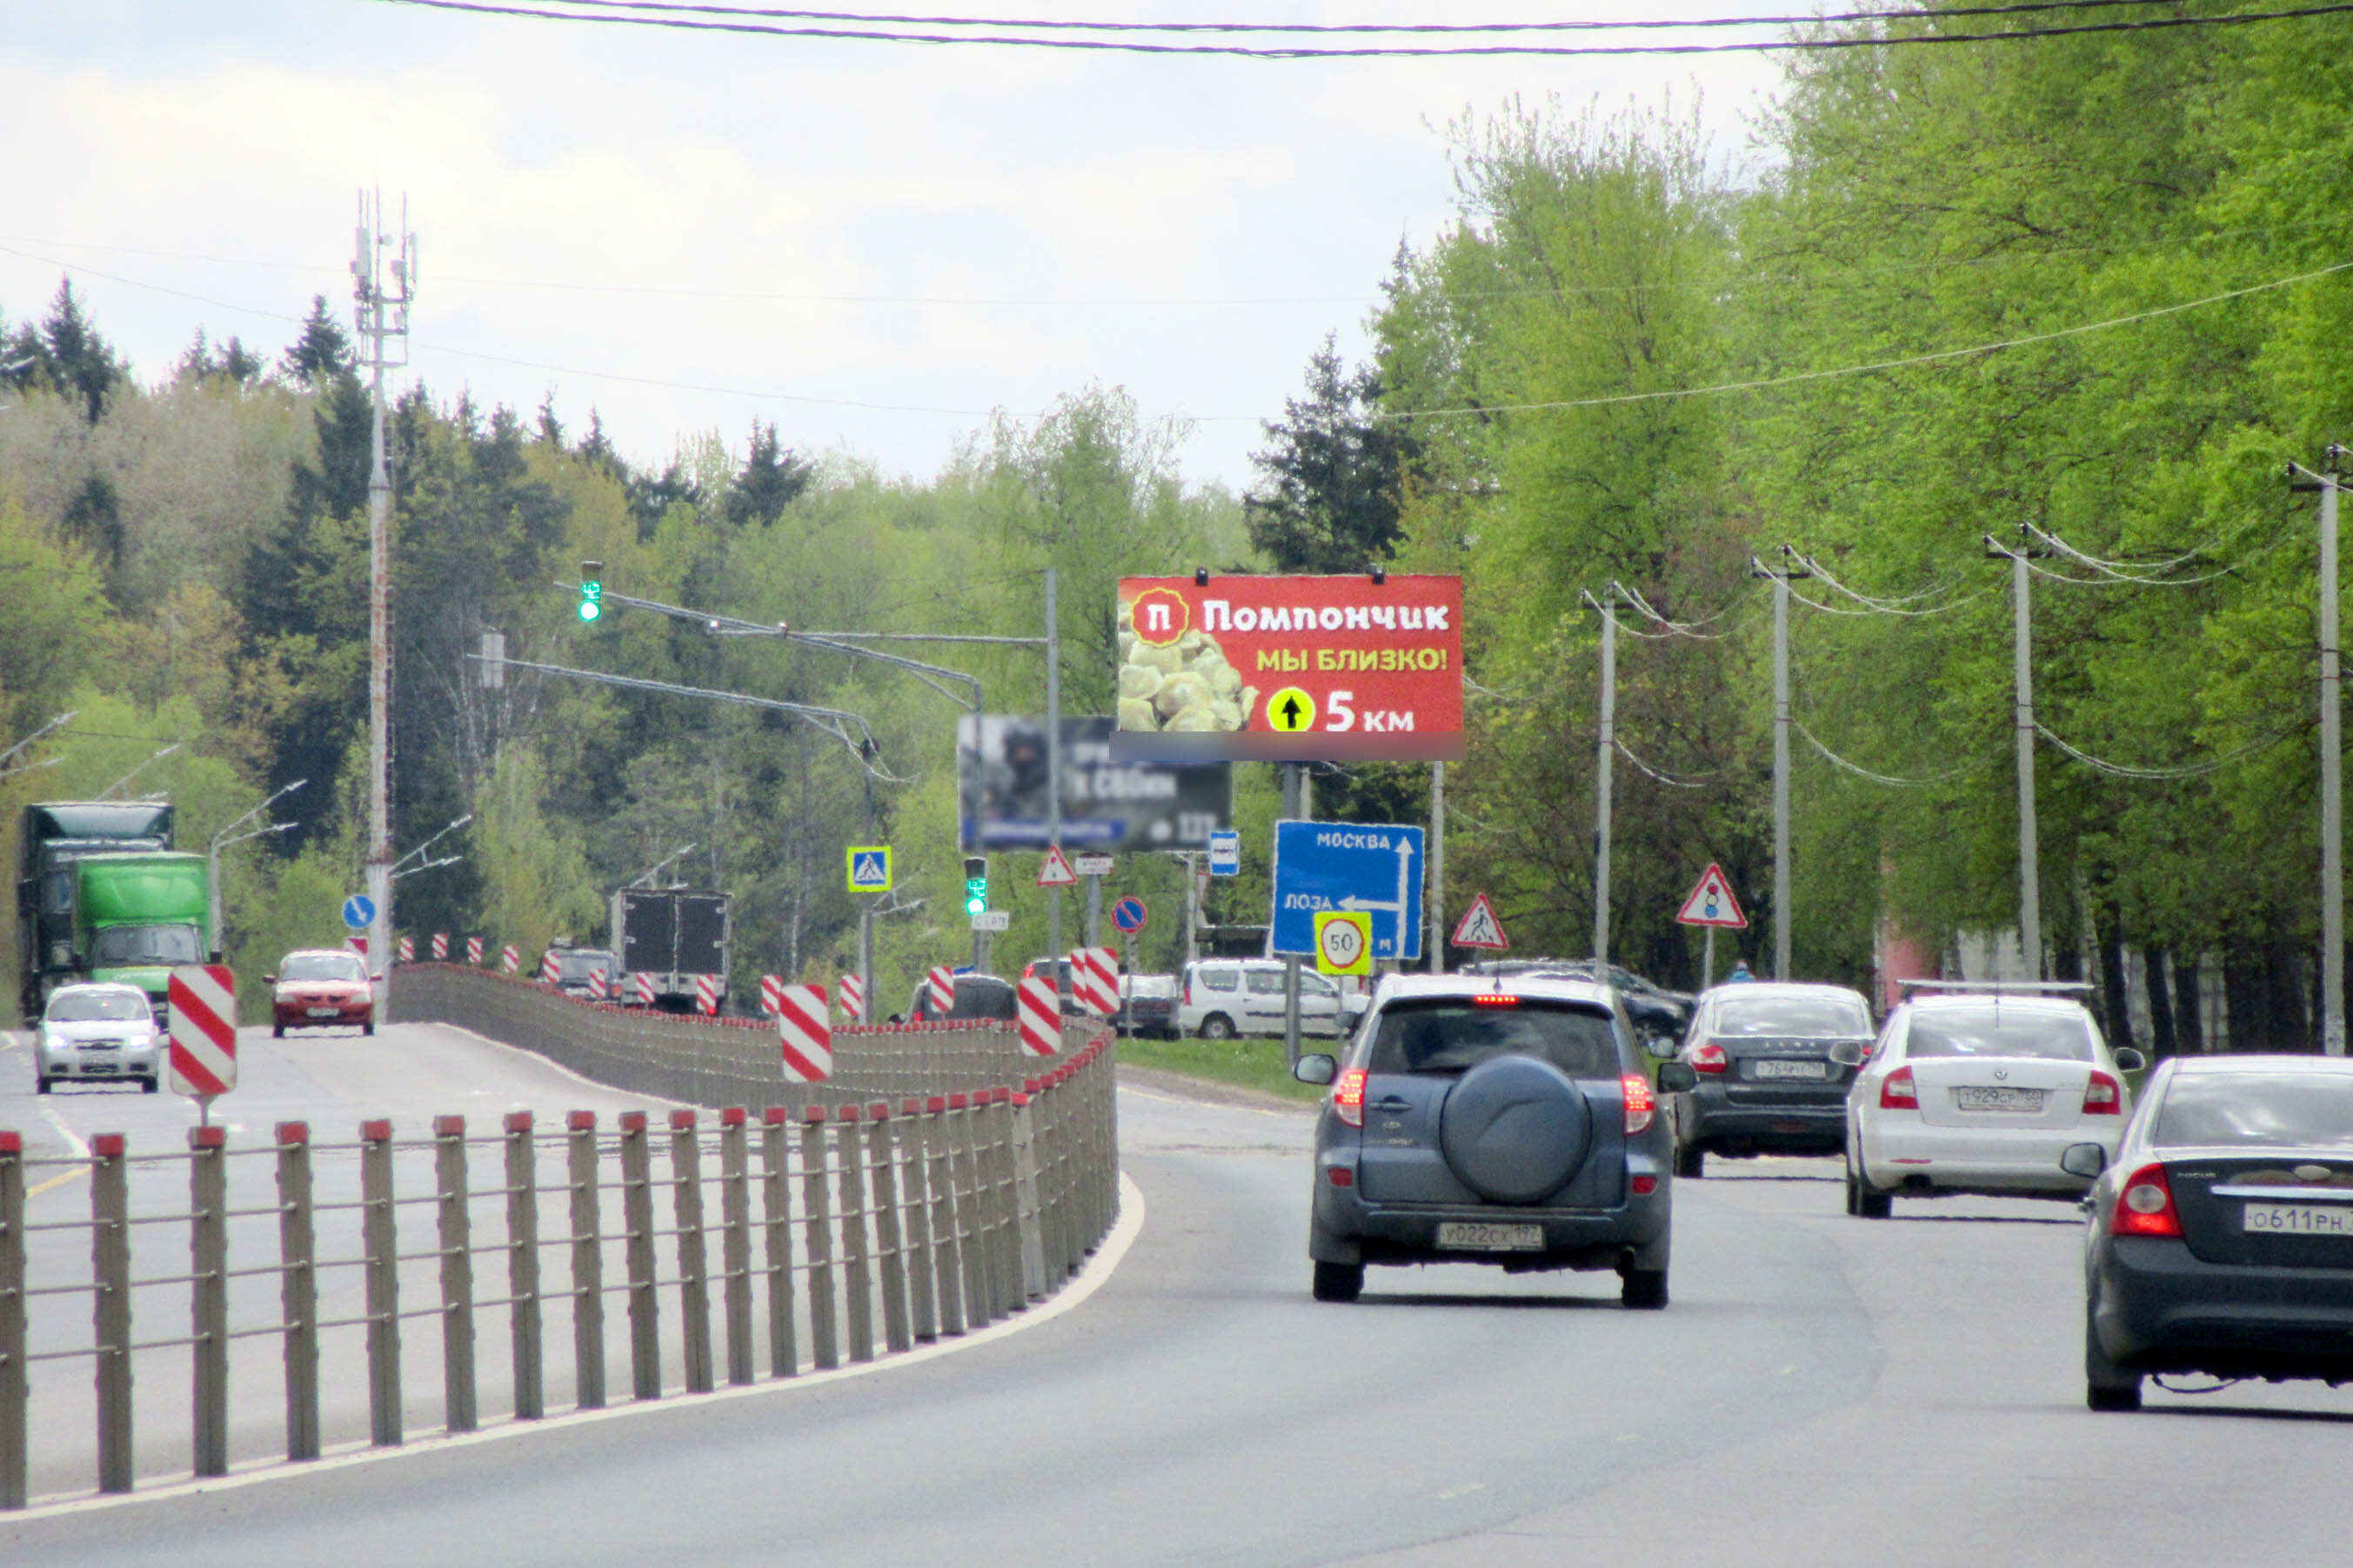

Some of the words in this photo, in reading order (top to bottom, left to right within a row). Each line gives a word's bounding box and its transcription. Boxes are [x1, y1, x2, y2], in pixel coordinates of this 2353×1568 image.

[1202, 600, 1450, 631] Помпончик
[1256, 649, 1308, 671] МЫ
[1317, 648, 1447, 671] БЛИЗКО!
[1325, 690, 1355, 731] 5
[1316, 832, 1391, 851] МОСКВА
[1284, 893, 1334, 910] ЛОЗА
[1330, 933, 1354, 951] 50
